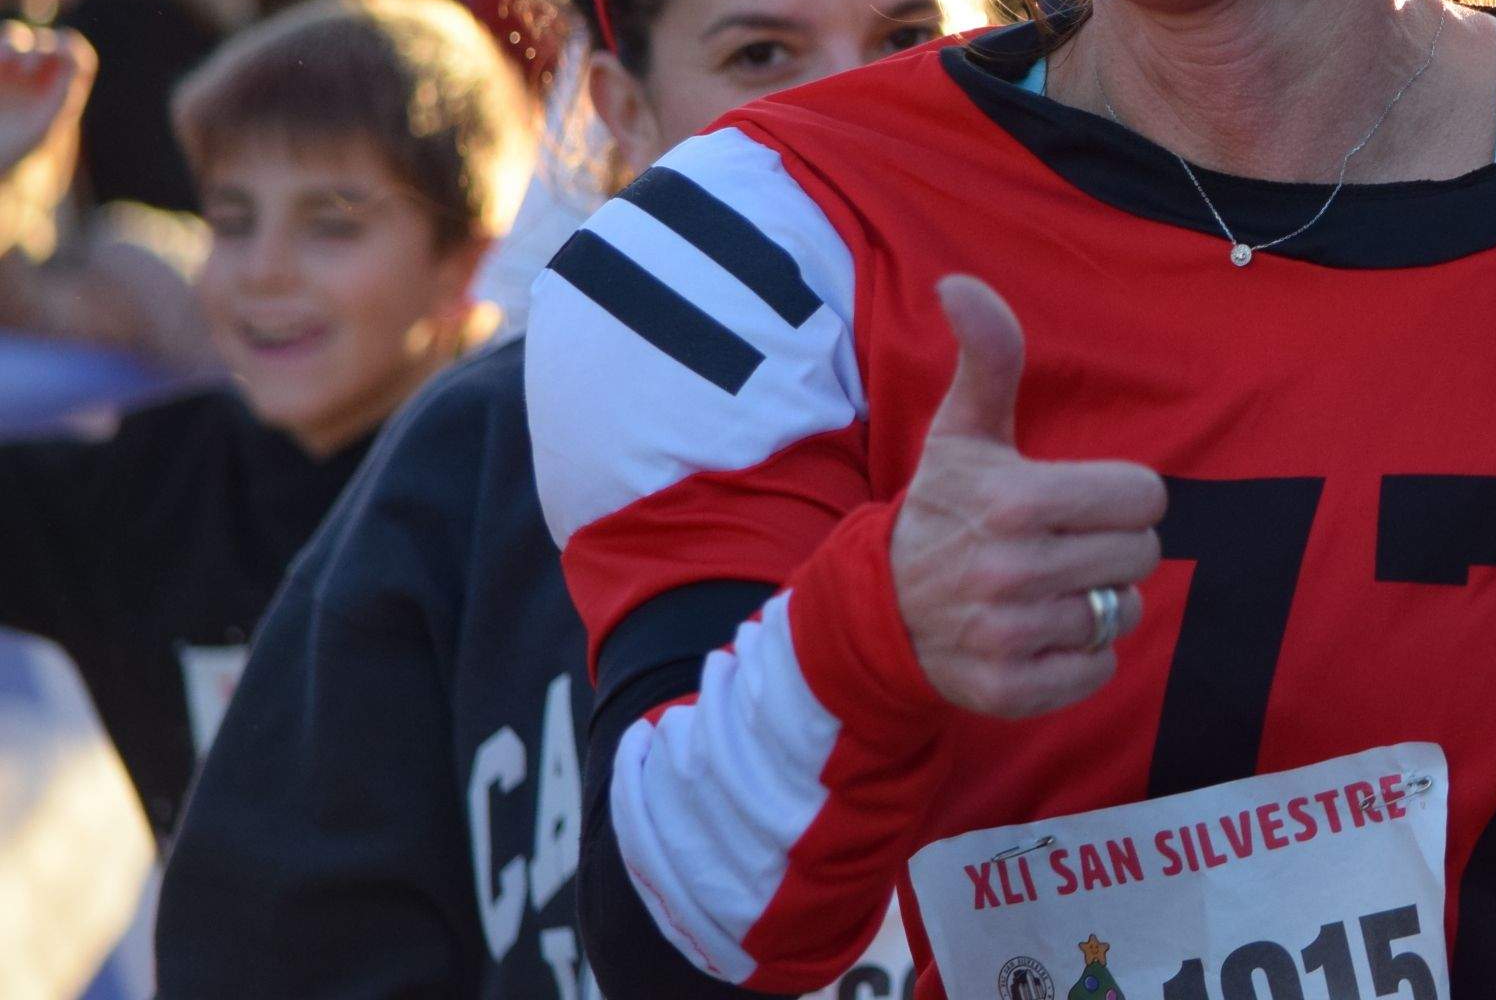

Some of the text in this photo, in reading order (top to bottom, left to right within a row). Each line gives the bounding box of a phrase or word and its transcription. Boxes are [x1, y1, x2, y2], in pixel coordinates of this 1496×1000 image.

[964, 774, 1408, 909] XLI SAN SILVESTRE
